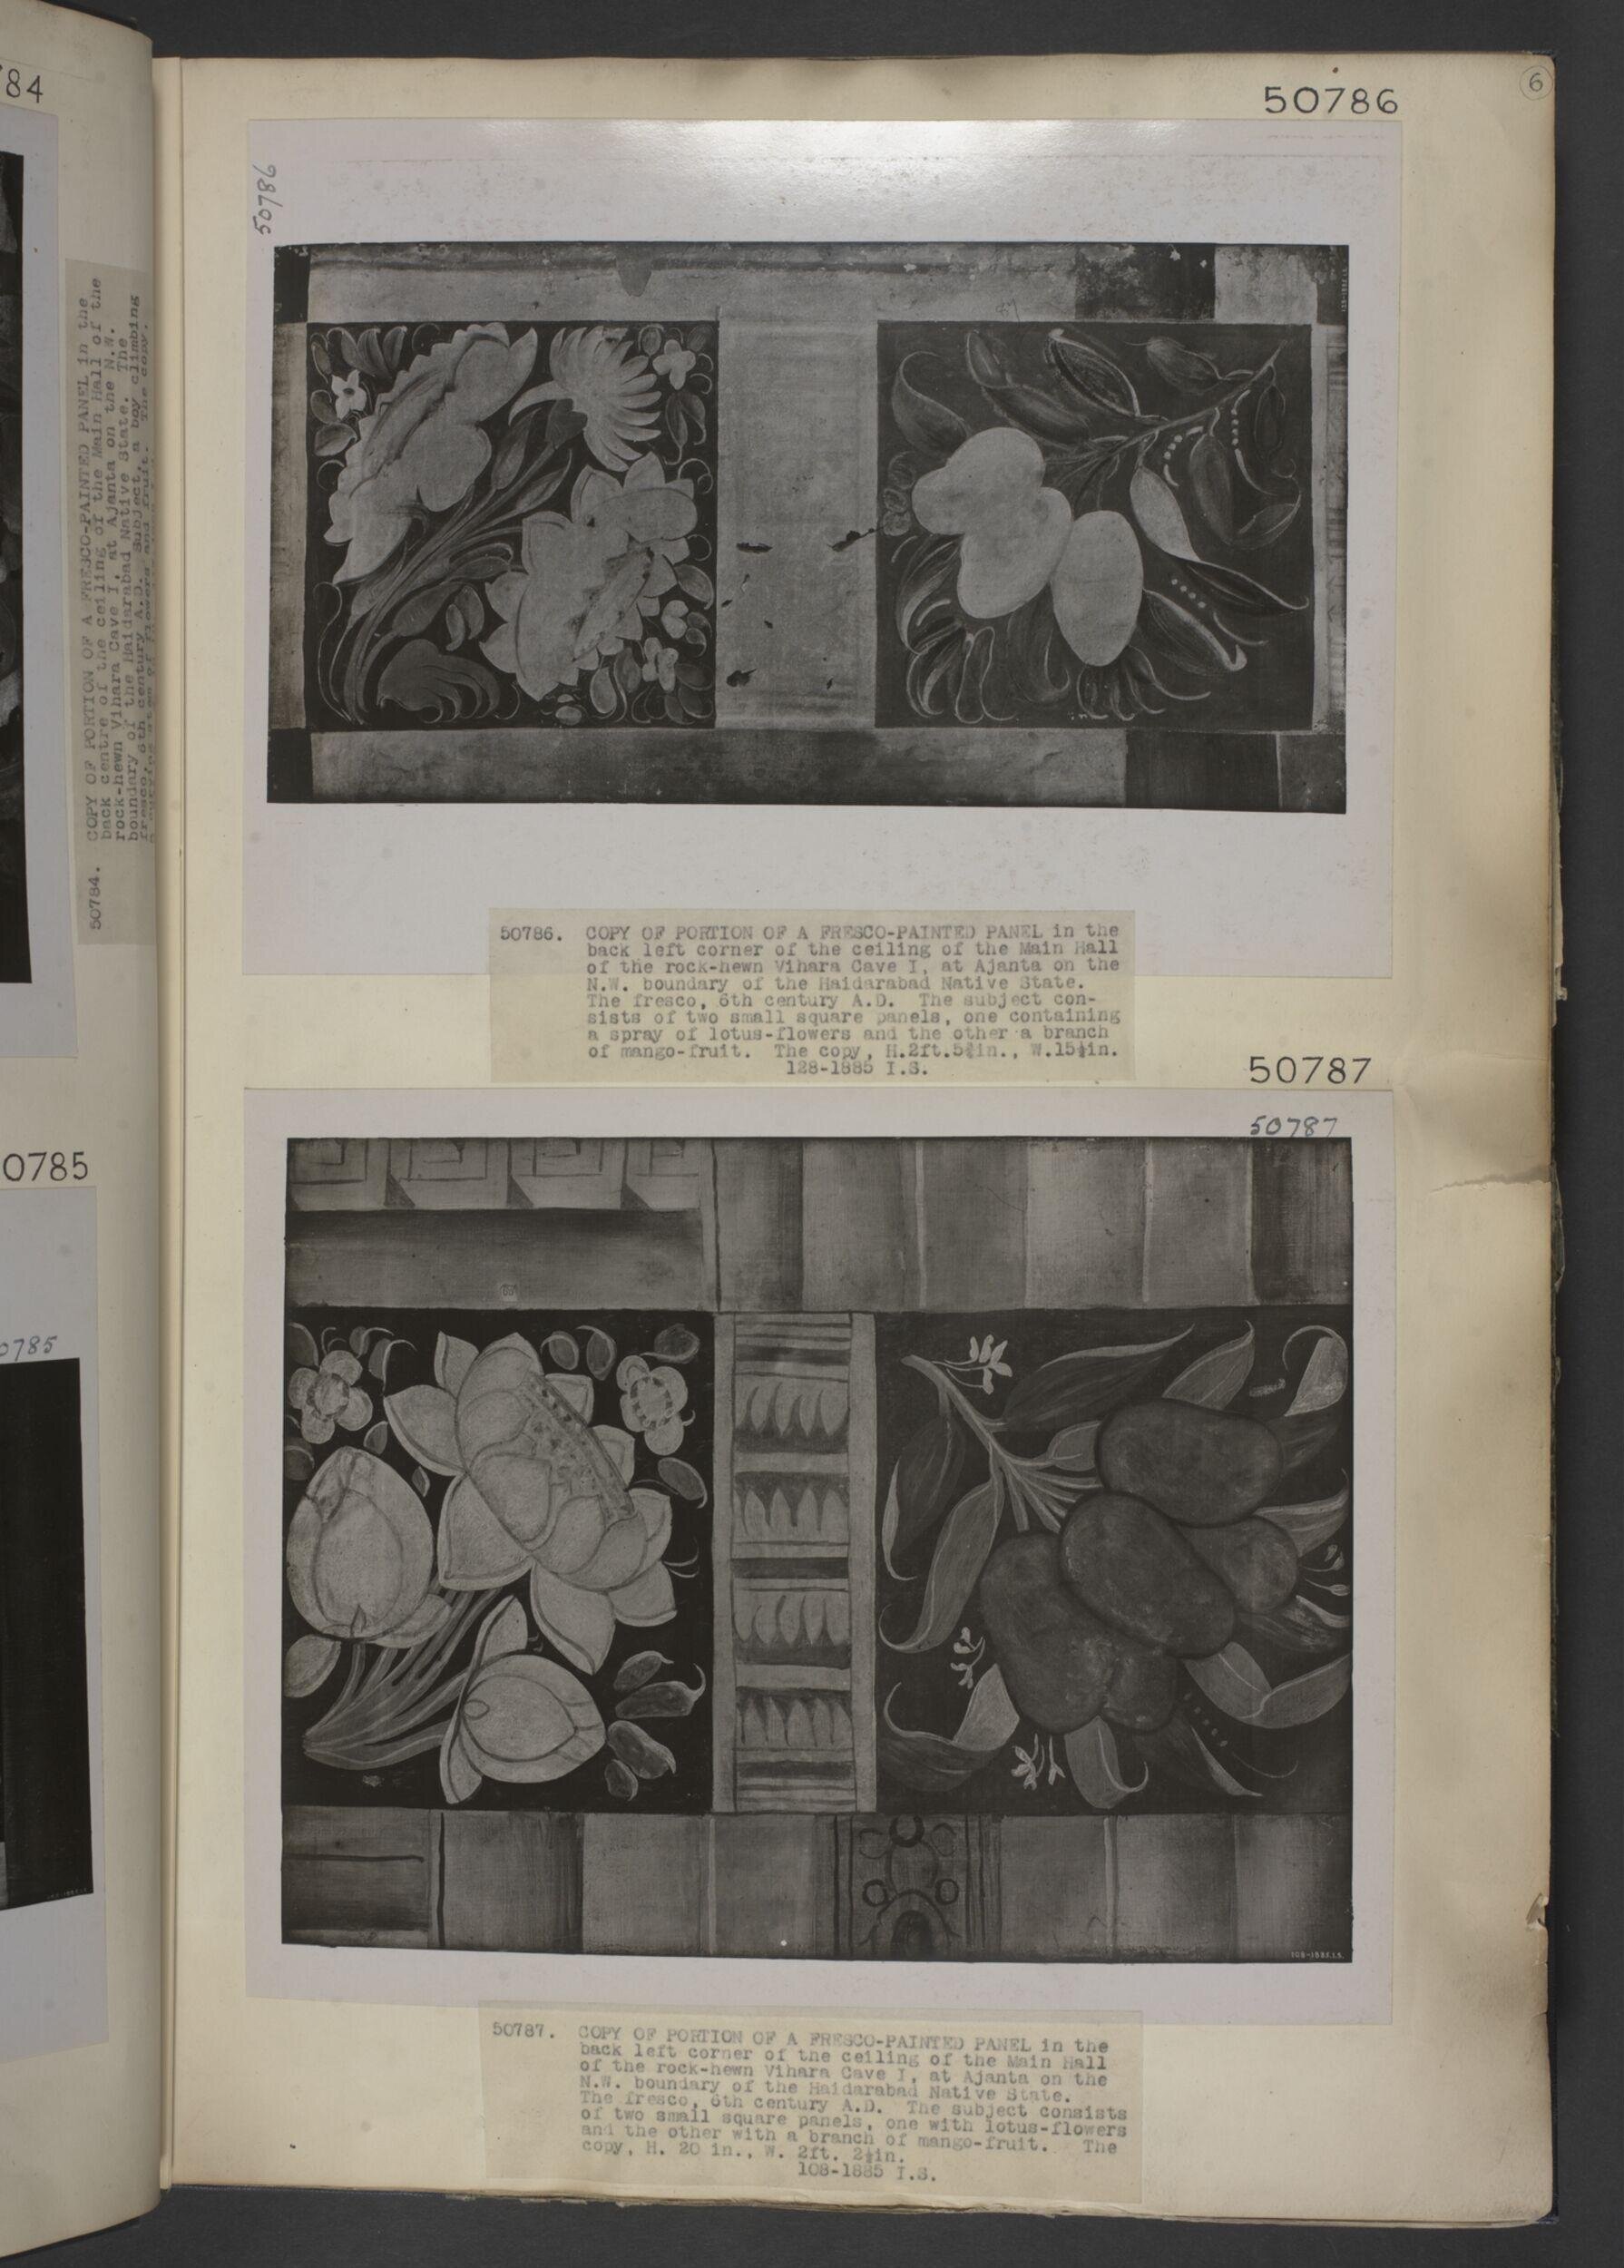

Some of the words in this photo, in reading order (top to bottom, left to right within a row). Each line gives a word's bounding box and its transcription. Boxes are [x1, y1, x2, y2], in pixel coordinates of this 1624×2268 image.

[0, 64, 44, 103] 84
[1529, 73, 1543, 91] 6
[1264, 86, 1398, 114] 50786
[252, 164, 283, 235] 50786
[91, 278, 102, 310] the
[76, 298, 88, 330] the
[91, 323, 102, 344] of
[78, 343, 89, 364] in
[92, 357, 103, 400] Hall
[78, 376, 90, 432] PANEL
[93, 413, 104, 456] Main
[93, 469, 104, 502] the
[94, 514, 105, 535] of
[95, 548, 110, 625] ceiling
[83, 615, 93, 625] A
[83, 638, 94, 659] OF
[97, 638, 108, 670] the
[97, 683, 108, 704] of
[83, 671, 96, 749] PORTION
[99, 717, 110, 783] centre
[85, 762, 97, 784] OF
[86, 797, 98, 840] COPY
[100, 796, 111, 839] back
[88, 867, 101, 929] 50784.
[501, 926, 562, 941] 50786.
[586, 926, 629, 941] COPY
[641, 925, 665, 941] OF
[676, 925, 752, 940] PORTION
[763, 925, 787, 940] OF
[797, 924, 808, 939] A
[986, 924, 1043, 938] PANEL
[1053, 924, 1074, 937] in
[1086, 923, 1119, 937] the
[588, 943, 630, 957] back
[644, 943, 685, 957] left
[697, 945, 763, 957] corner
[775, 942, 796, 956] of
[808, 942, 841, 956] the
[852, 941, 931, 960] ceiling
[942, 941, 963, 955] of
[976, 941, 1008, 955] the
[1020, 941, 1063, 955] Main
[1075, 940, 1118, 955] Hall
[587, 960, 609, 974] of
[620, 960, 652, 974] the
[666, 959, 763, 974] rock-hewn
[775, 959, 840, 973] Vihara
[851, 958, 896, 973] Cave
[942, 959, 963, 973] at
[975, 957, 1042, 976] Ajanta
[1053, 961, 1074, 972] on
[1088, 957, 1120, 972] the
[587, 977, 628, 992] N.W.
[644, 976, 728, 995] boundary
[743, 976, 762, 991] of
[775, 976, 807, 991] the
[819, 976, 930, 991] Haidarabad
[942, 975, 1008, 991] Native
[1020, 975, 1083, 990] State.
[587, 993, 621, 1008] The
[633, 992, 706, 1012] fresco,
[765, 993, 841, 1011] century
[853, 992, 894, 1006] A.D.
[919, 992, 953, 1006] The
[964, 991, 1042, 1010] subject
[1054, 994, 1095, 1005] con-
[588, 1011, 641, 1025] sists
[654, 1010, 675, 1024] of
[687, 1011, 719, 1024] two
[730, 1009, 784, 1024] small
[797, 1012, 863, 1027] square
[878, 1008, 950, 1027] panels,
[964, 1012, 997, 1022] one
[1010, 1009, 1120, 1026] containing
[588, 1031, 599, 1041] a
[611, 1031, 662, 1045] spray
[676, 1026, 697, 1041] of
[709, 1025, 850, 1041] lotus-flowers
[864, 1025, 897, 1040] and
[908, 1025, 941, 1040] the
[954, 1025, 1008, 1040] other
[1021, 1028, 1032, 1040] a
[1044, 1024, 1108, 1039] branch
[589, 1043, 609, 1058] of
[621, 1043, 749, 1061] mango-fruit.
[774, 1043, 807, 1058] The
[819, 1046, 872, 1061] copy,
[788, 1061, 873, 1075] 128-1885
[887, 1061, 927, 1076] I.S.
[1249, 1056, 1372, 1084] 50787
[1250, 1115, 1337, 1137] 50787
[493, 2021, 554, 2038] 50787.
[579, 2025, 621, 2040] COPY
[633, 2026, 656, 2041] OF
[667, 2027, 742, 2043] PORTION
[753, 2029, 776, 2044] OF
[788, 2030, 797, 2045] A
[974, 2035, 1032, 2051] PANEL
[1042, 2038, 1062, 2052] in
[1075, 2038, 1109, 2053] the
[581, 2090, 612, 2106] The
[625, 2091, 698, 2111] fresco,
[754, 2096, 831, 2116] century
[843, 2097, 882, 2113] A.D.
[907, 2099, 940, 2115] The
[952, 2100, 1027, 2121] subject
[1040, 2104, 1127, 2120] consists
[581, 2107, 602, 2121] of
[614, 2108, 644, 2123] two
[656, 2108, 709, 2125] small
[722, 2114, 787, 2131] square
[798, 2113, 872, 2133] panels,
[886, 2119, 918, 2131] one
[929, 2116, 973, 2133] with
[985, 2118, 1127, 2137] lotus-flowers
[582, 2122, 613, 2137] and
[625, 2124, 657, 2139] the
[668, 2125, 721, 2141] other
[732, 2127, 776, 2143] with
[788, 2133, 797, 2144] a
[809, 2129, 874, 2146] branch
[886, 2132, 906, 2147] of
[919, 2133, 1047, 2156] mango-fruit.
[1083, 2138, 1117, 2154] The
[582, 2141, 632, 2157] copy,
[646, 2139, 665, 2155] H.
[680, 2140, 700, 2156] 20
[712, 2143, 752, 2161] in.,
[765, 2144, 784, 2158] W.
[798, 2145, 837, 2160] 2ft.
[798, 2162, 884, 2177] 108-1885
[897, 2166, 935, 2182] I.S.
